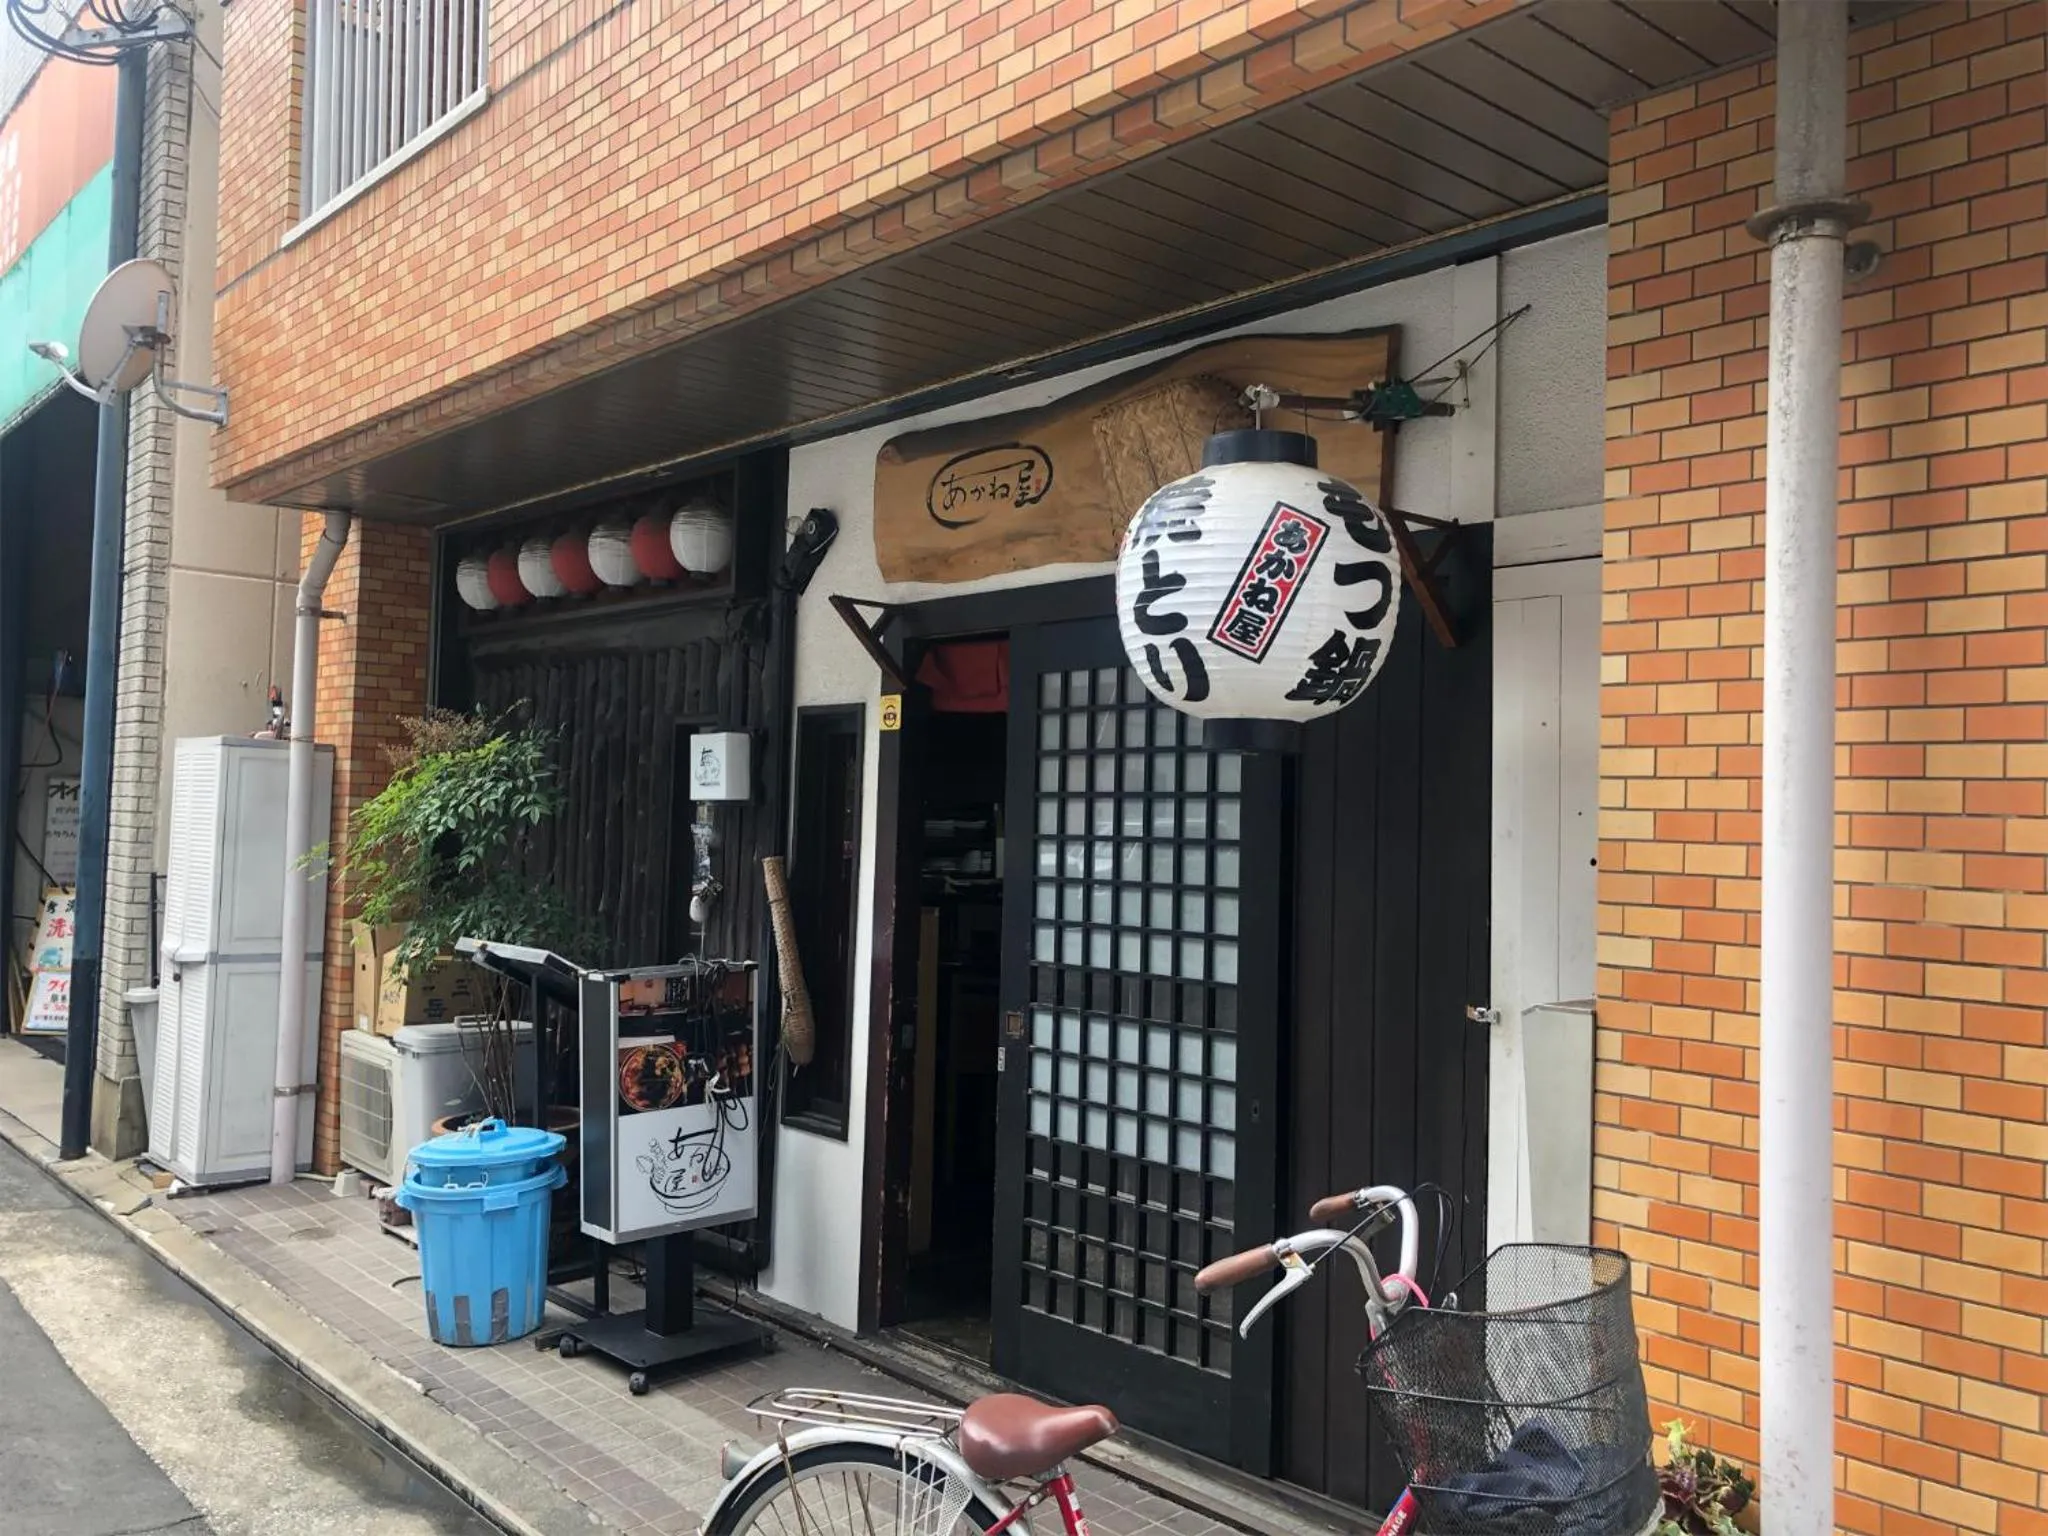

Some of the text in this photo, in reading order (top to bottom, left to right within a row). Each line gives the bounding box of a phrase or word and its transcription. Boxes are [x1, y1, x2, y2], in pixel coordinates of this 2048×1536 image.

[941, 459, 1036, 510] あかね屋
[1224, 517, 1310, 648] あかね屋
[1284, 477, 1393, 705] もつ鍋
